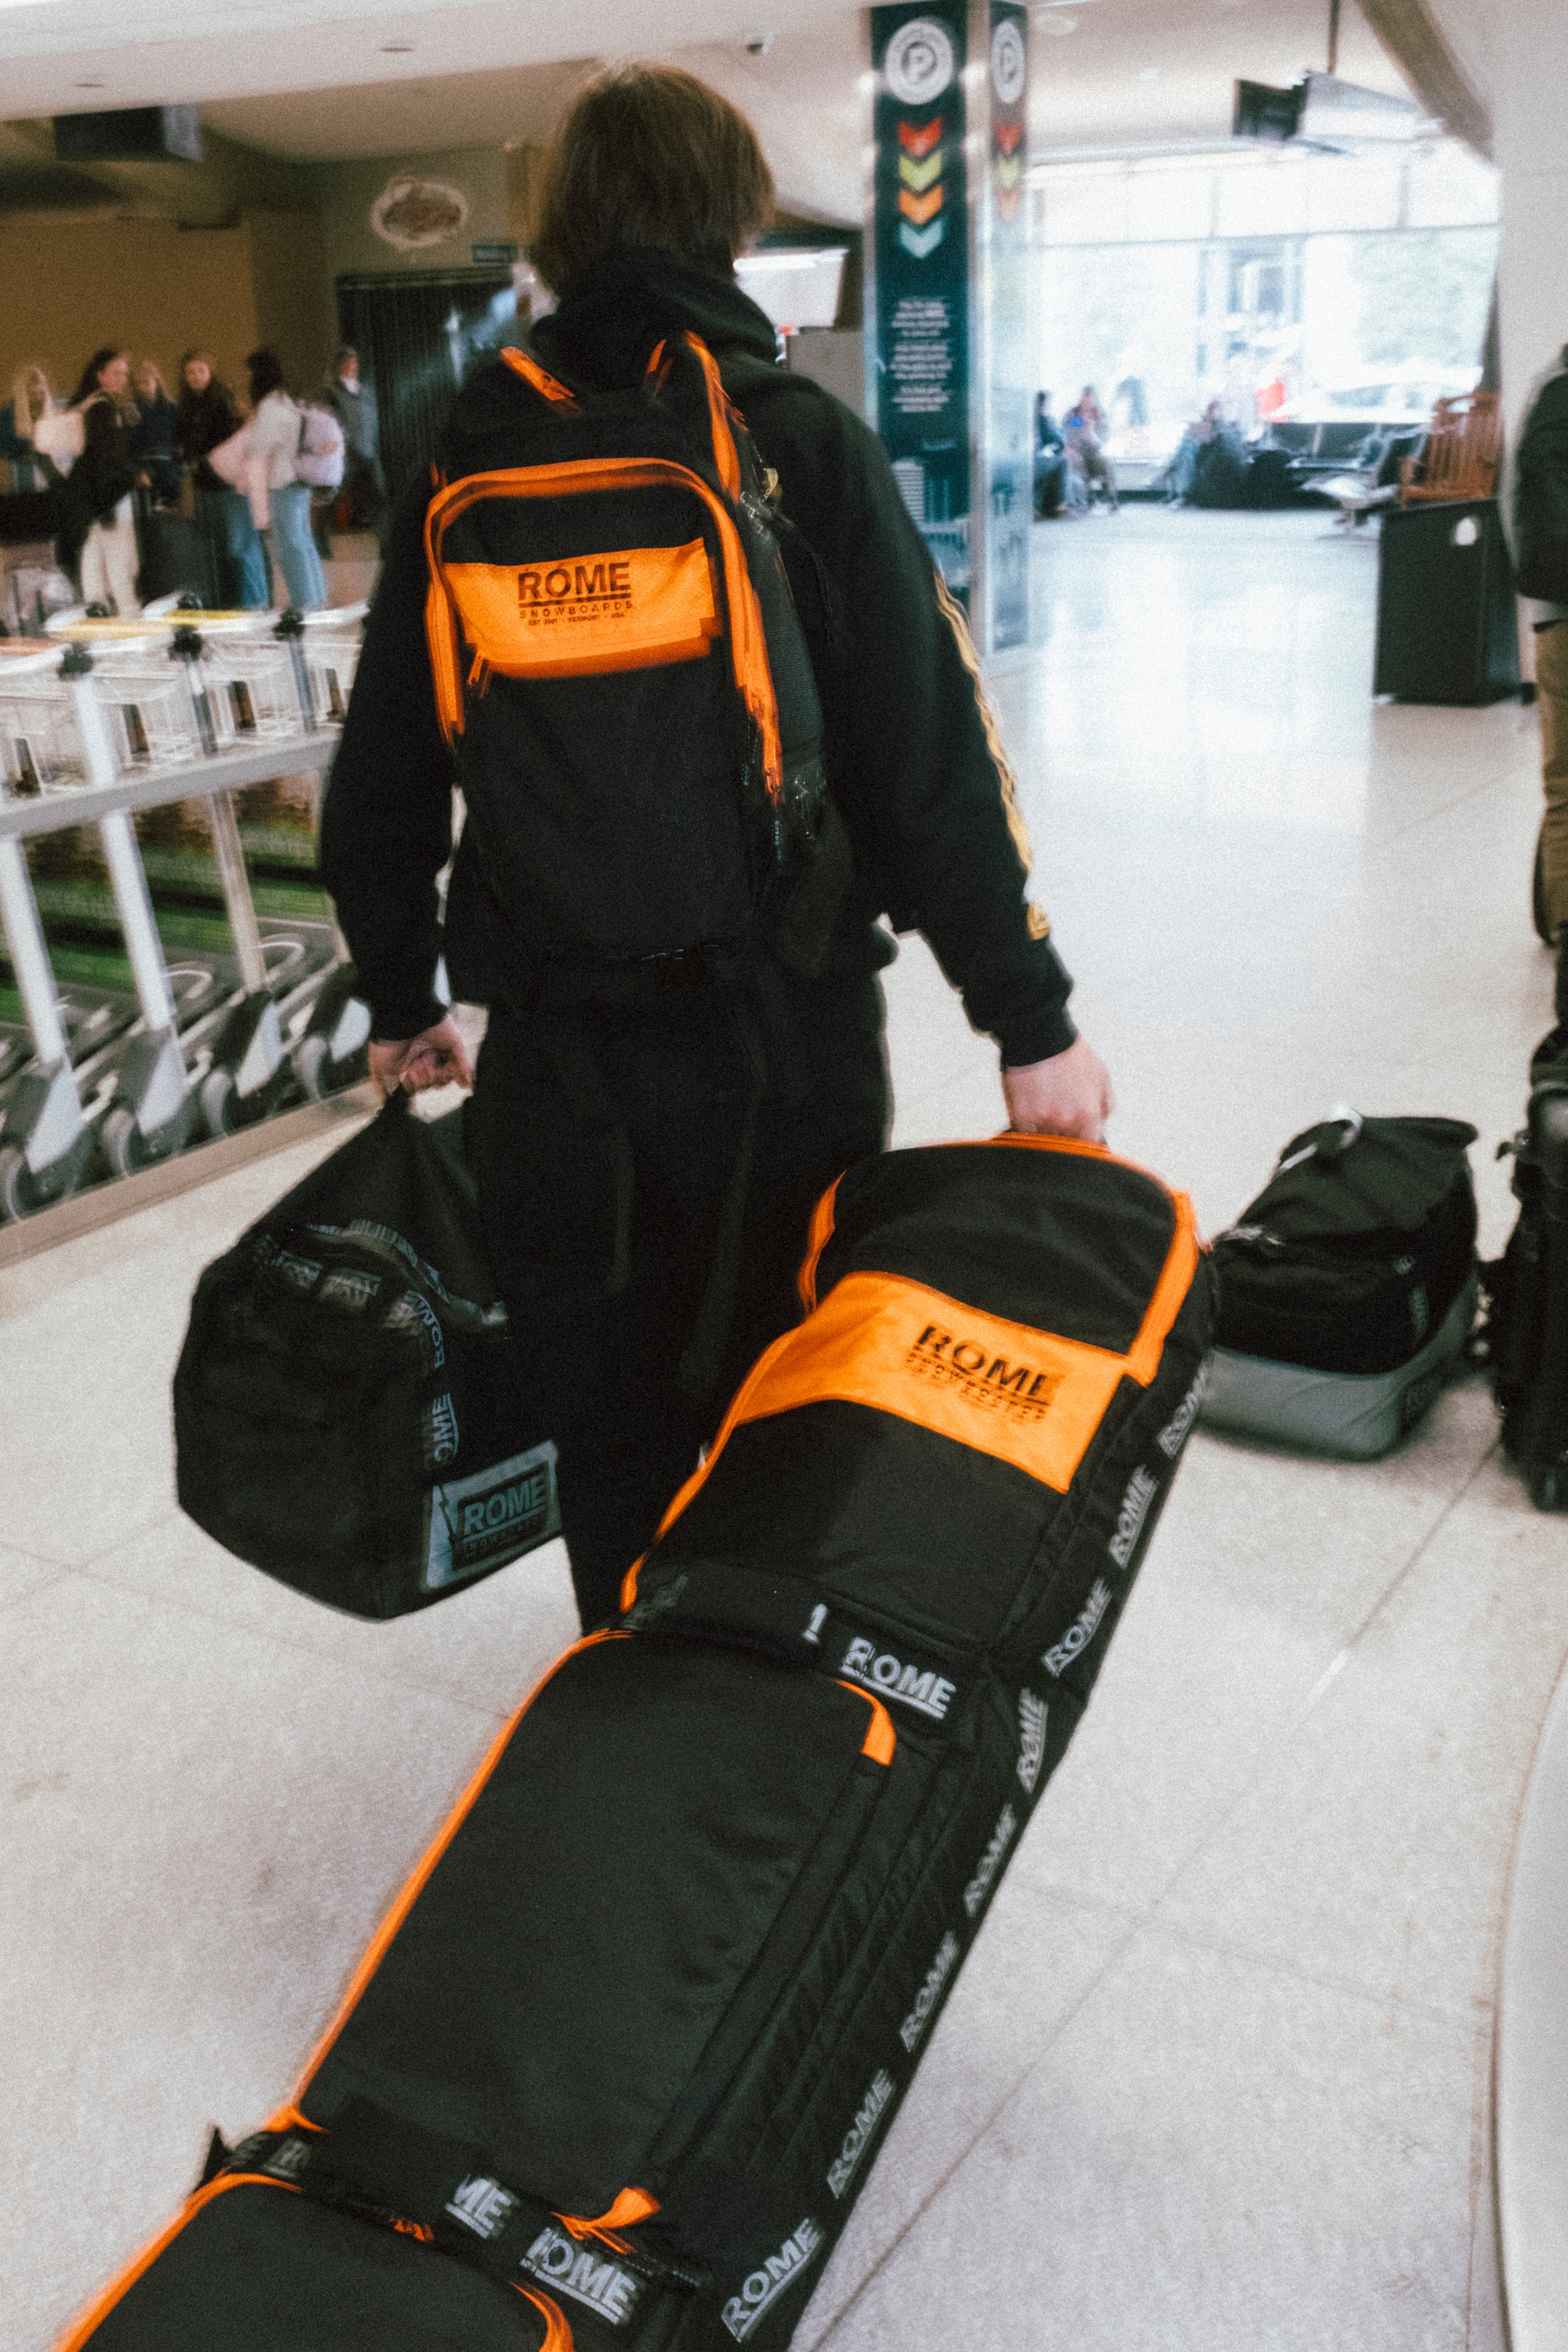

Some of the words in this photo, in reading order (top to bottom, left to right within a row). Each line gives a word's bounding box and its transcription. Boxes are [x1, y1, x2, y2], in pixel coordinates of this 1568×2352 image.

[518, 562, 632, 600] ROME
[519, 600, 633, 619] SNOWBOARDS
[568, 614, 600, 623] VERMONT
[916, 1324, 1060, 1399] ROME
[464, 1474, 548, 1536] ROME
[1108, 1464, 1159, 1568] ROME
[1041, 1577, 1113, 1677] ROME
[841, 1636, 957, 1715] ROME
[827, 2069, 894, 2199] ROME
[721, 2218, 821, 2343] ROME
